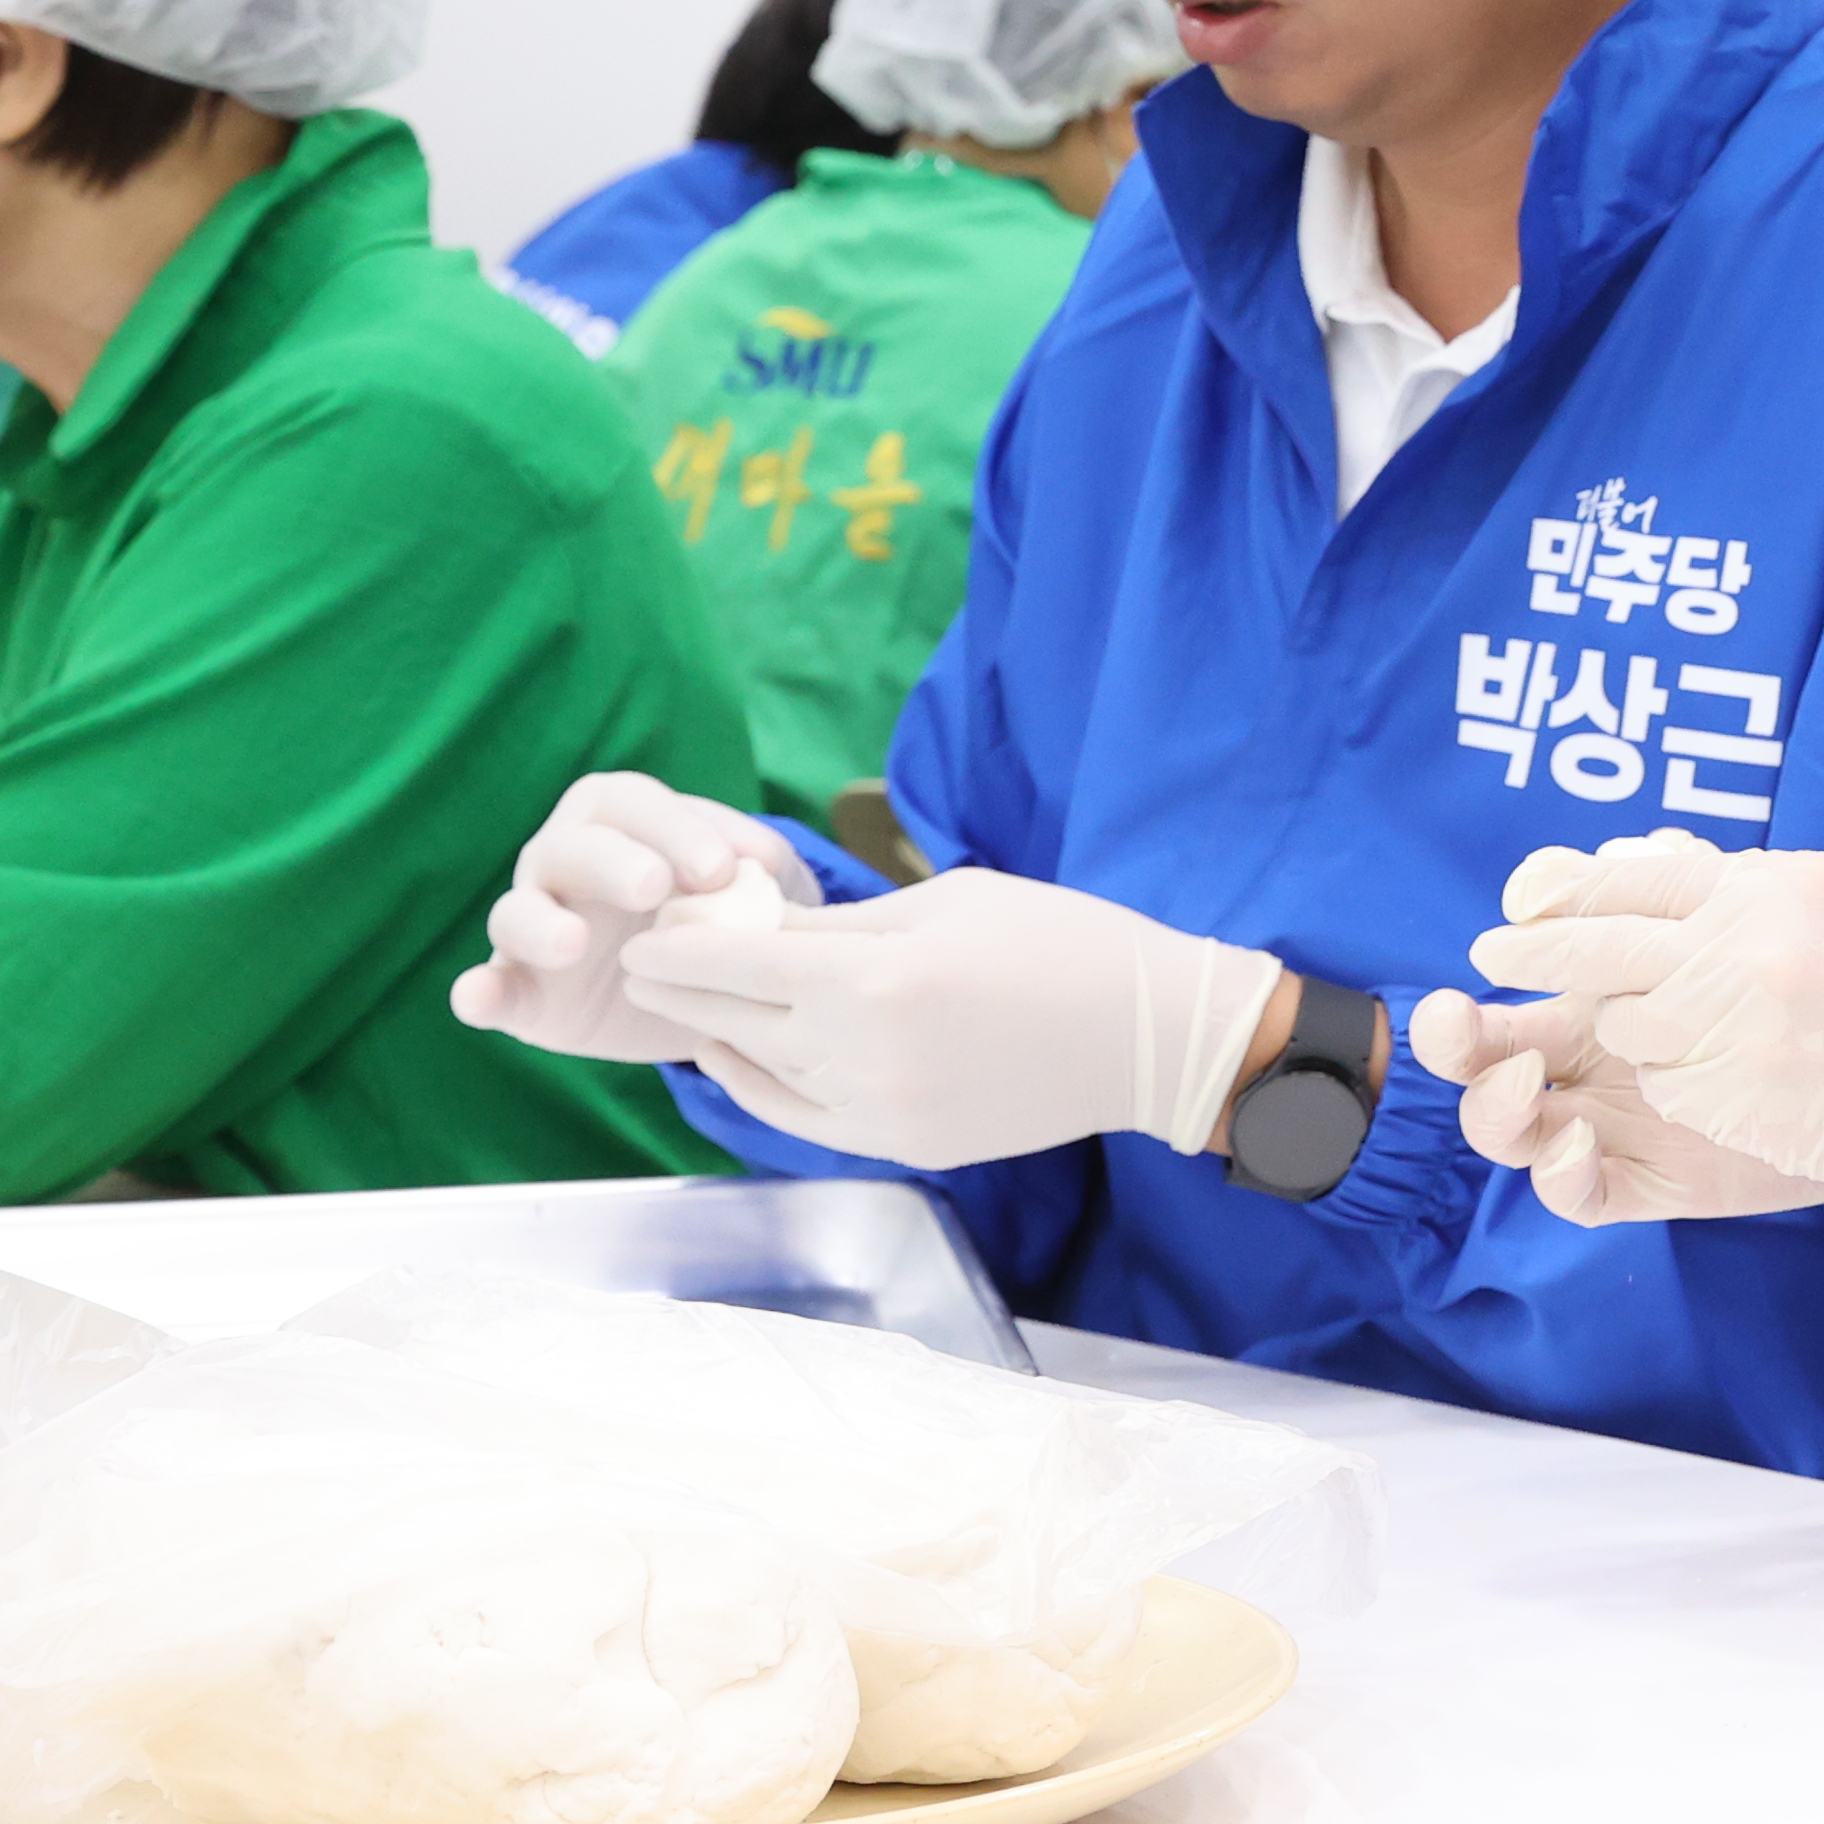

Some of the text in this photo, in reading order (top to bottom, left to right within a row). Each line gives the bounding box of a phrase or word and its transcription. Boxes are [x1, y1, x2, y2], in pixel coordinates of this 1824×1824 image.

[722, 329, 879, 399] SMU
[1575, 476, 1659, 534] 더불어
[1526, 516, 1754, 636] 민주당
[1454, 632, 1785, 823] 박상근
